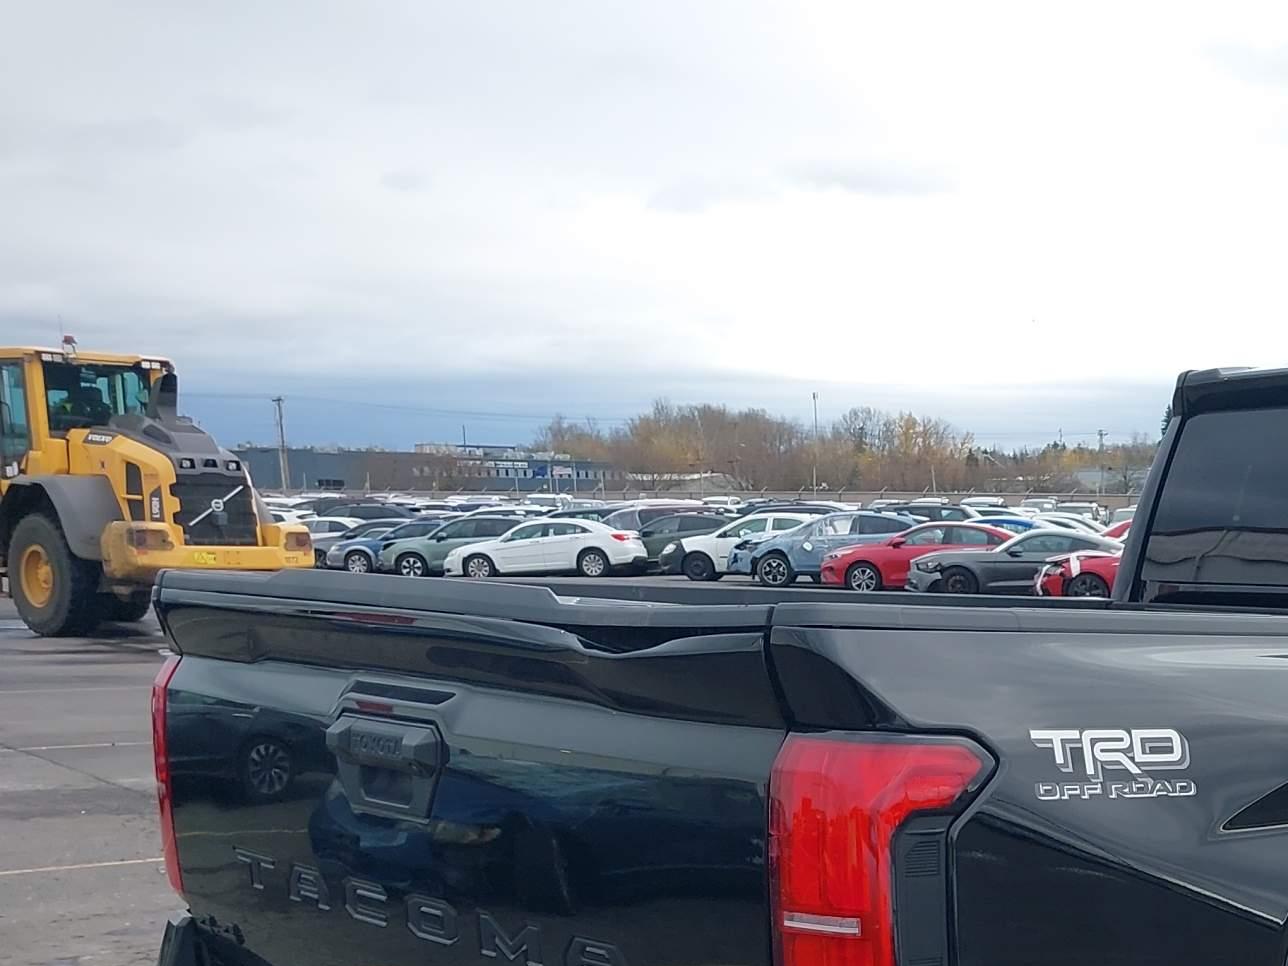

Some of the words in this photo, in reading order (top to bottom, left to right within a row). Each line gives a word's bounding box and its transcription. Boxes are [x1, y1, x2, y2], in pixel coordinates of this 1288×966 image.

[1029, 729, 1191, 782] TRD
[1035, 782, 1102, 800] OFF
[1106, 779, 1197, 799] ROAD
